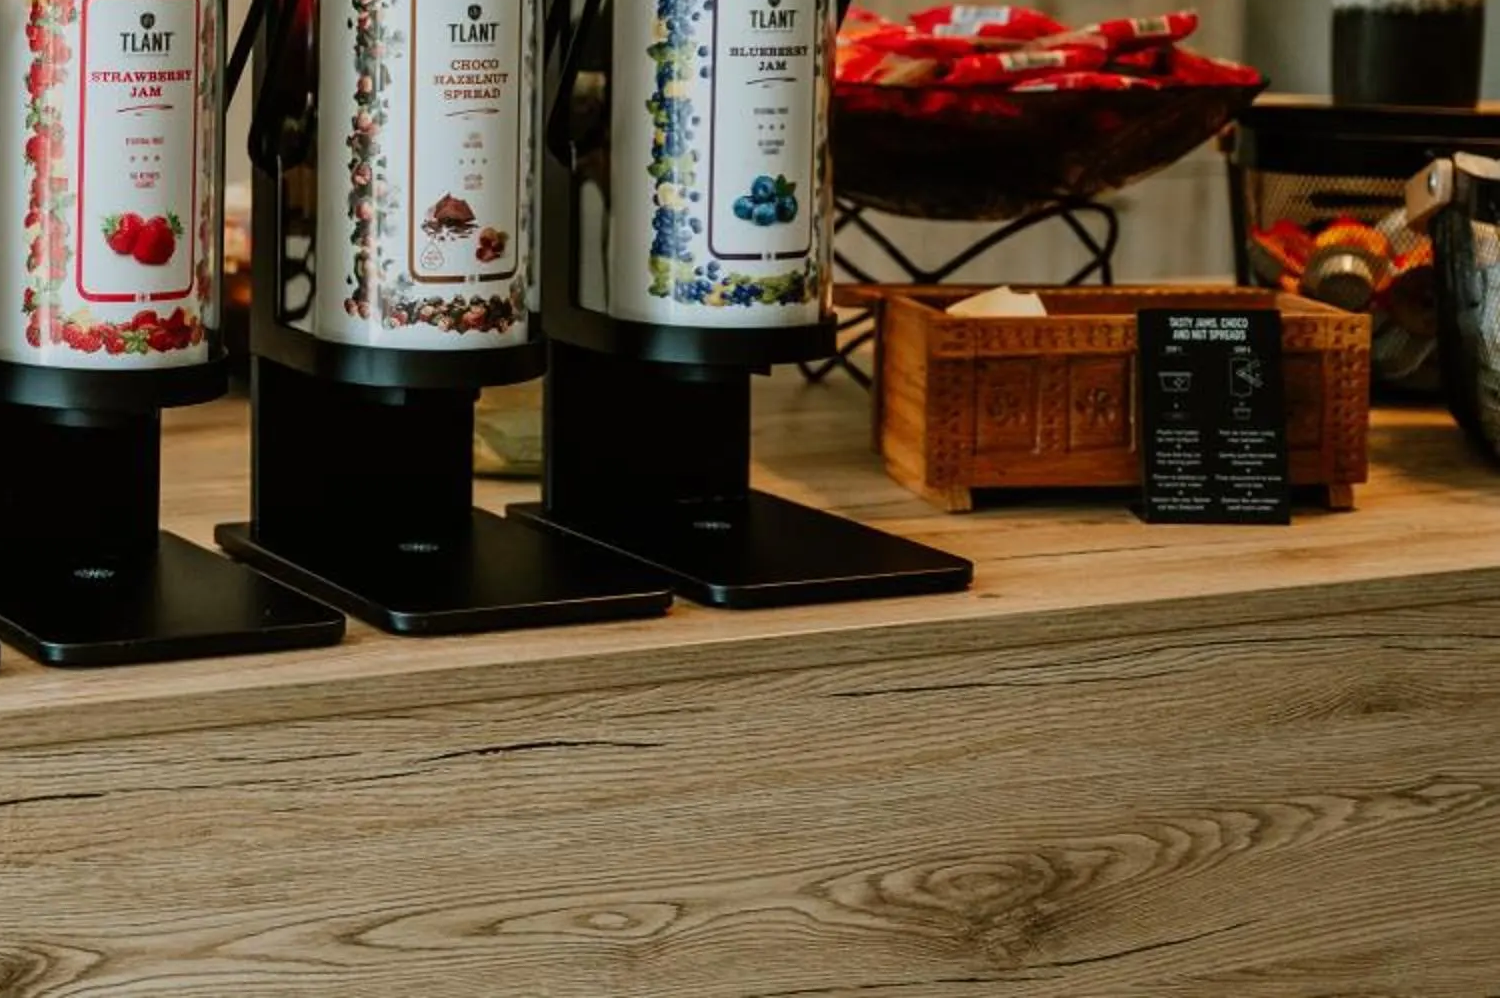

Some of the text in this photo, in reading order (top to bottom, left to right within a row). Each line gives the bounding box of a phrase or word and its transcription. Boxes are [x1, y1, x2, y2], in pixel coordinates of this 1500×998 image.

[749, 9, 797, 29] TLANT
[448, 23, 500, 42] TLANT
[120, 32, 173, 52] TLANT
[451, 58, 499, 71] CHOCO
[758, 60, 788, 71] JAM
[91, 69, 192, 82] STRAWBERRY
[434, 73, 509, 85] HAZELNUT
[130, 85, 163, 98] JAM
[444, 88, 501, 100] SPREAD
